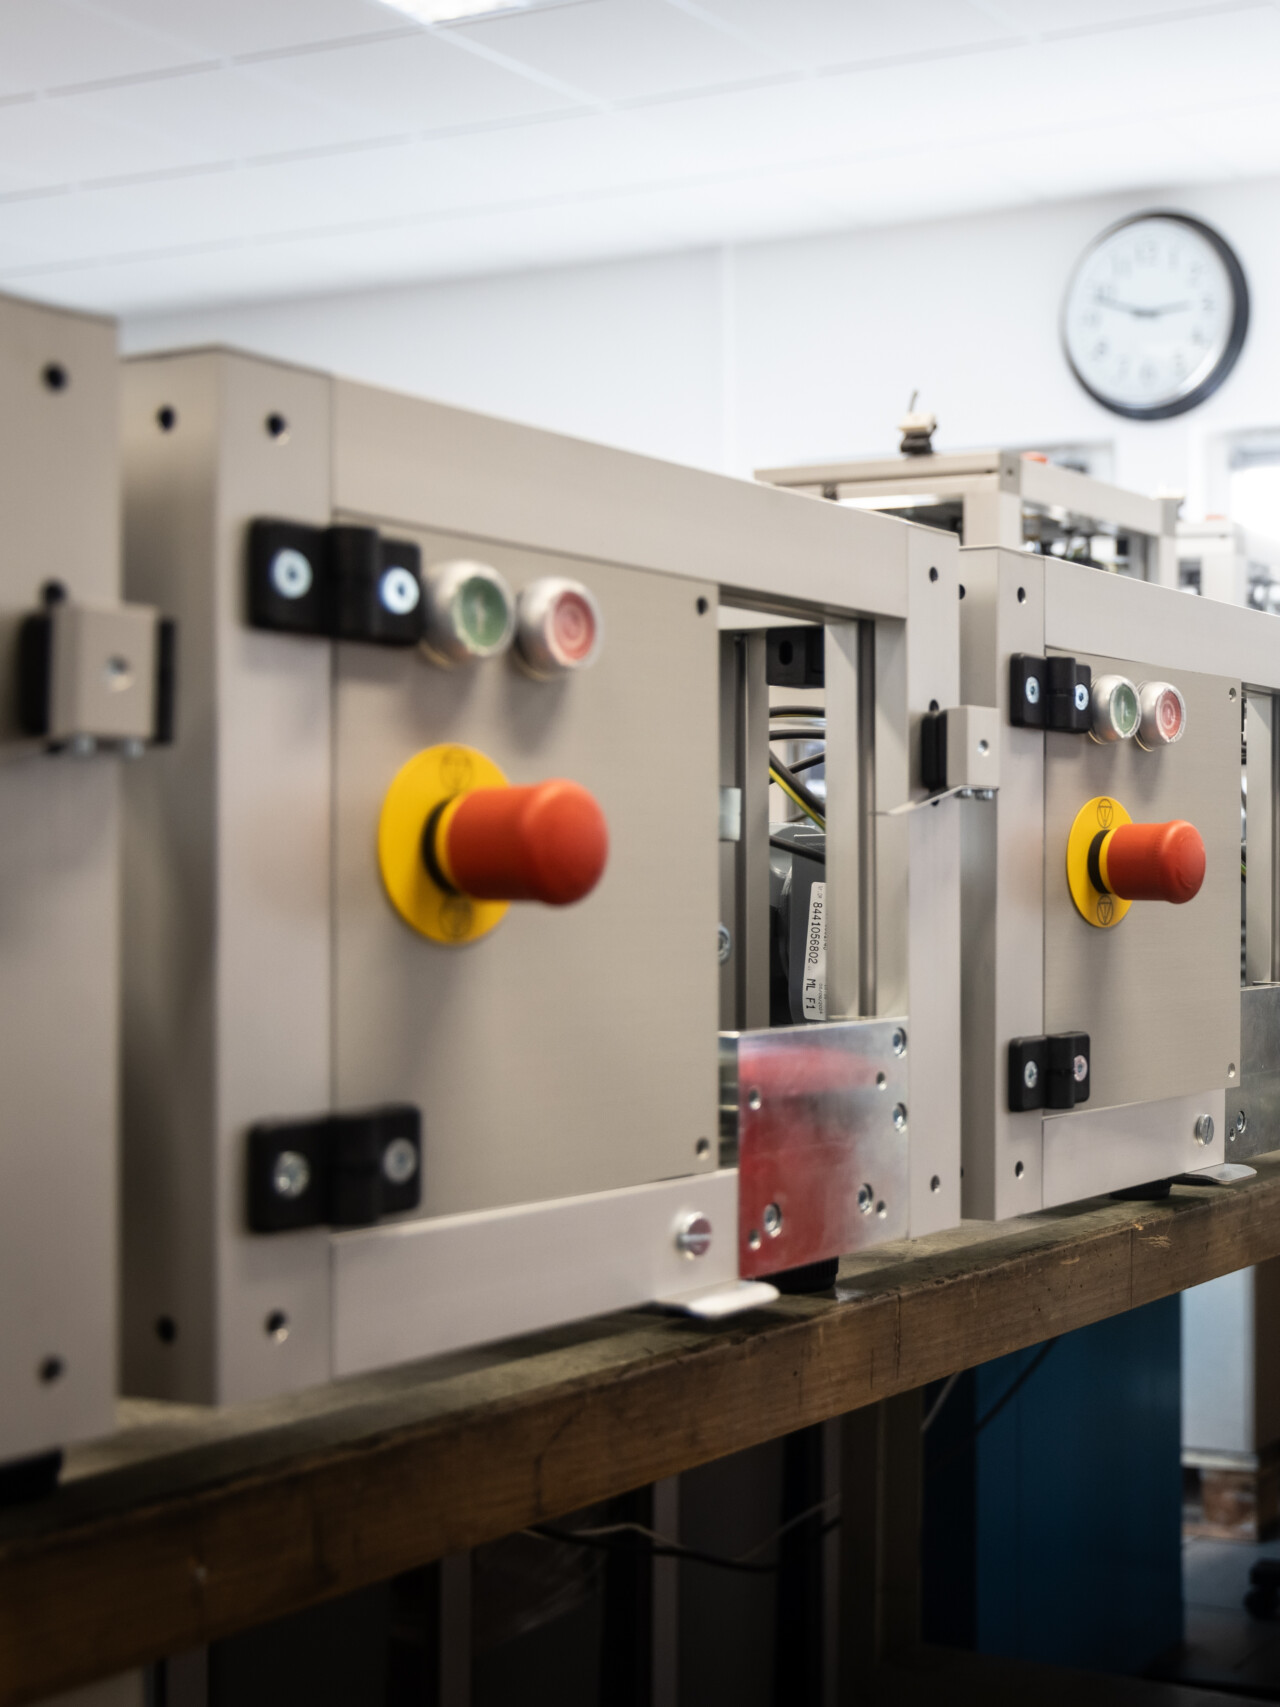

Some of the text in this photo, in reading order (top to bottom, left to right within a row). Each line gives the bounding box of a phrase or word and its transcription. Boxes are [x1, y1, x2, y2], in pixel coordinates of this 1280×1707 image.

[808, 901, 823, 964] 8441056802
[805, 978, 817, 991] ML
[805, 997, 816, 1010] F1
